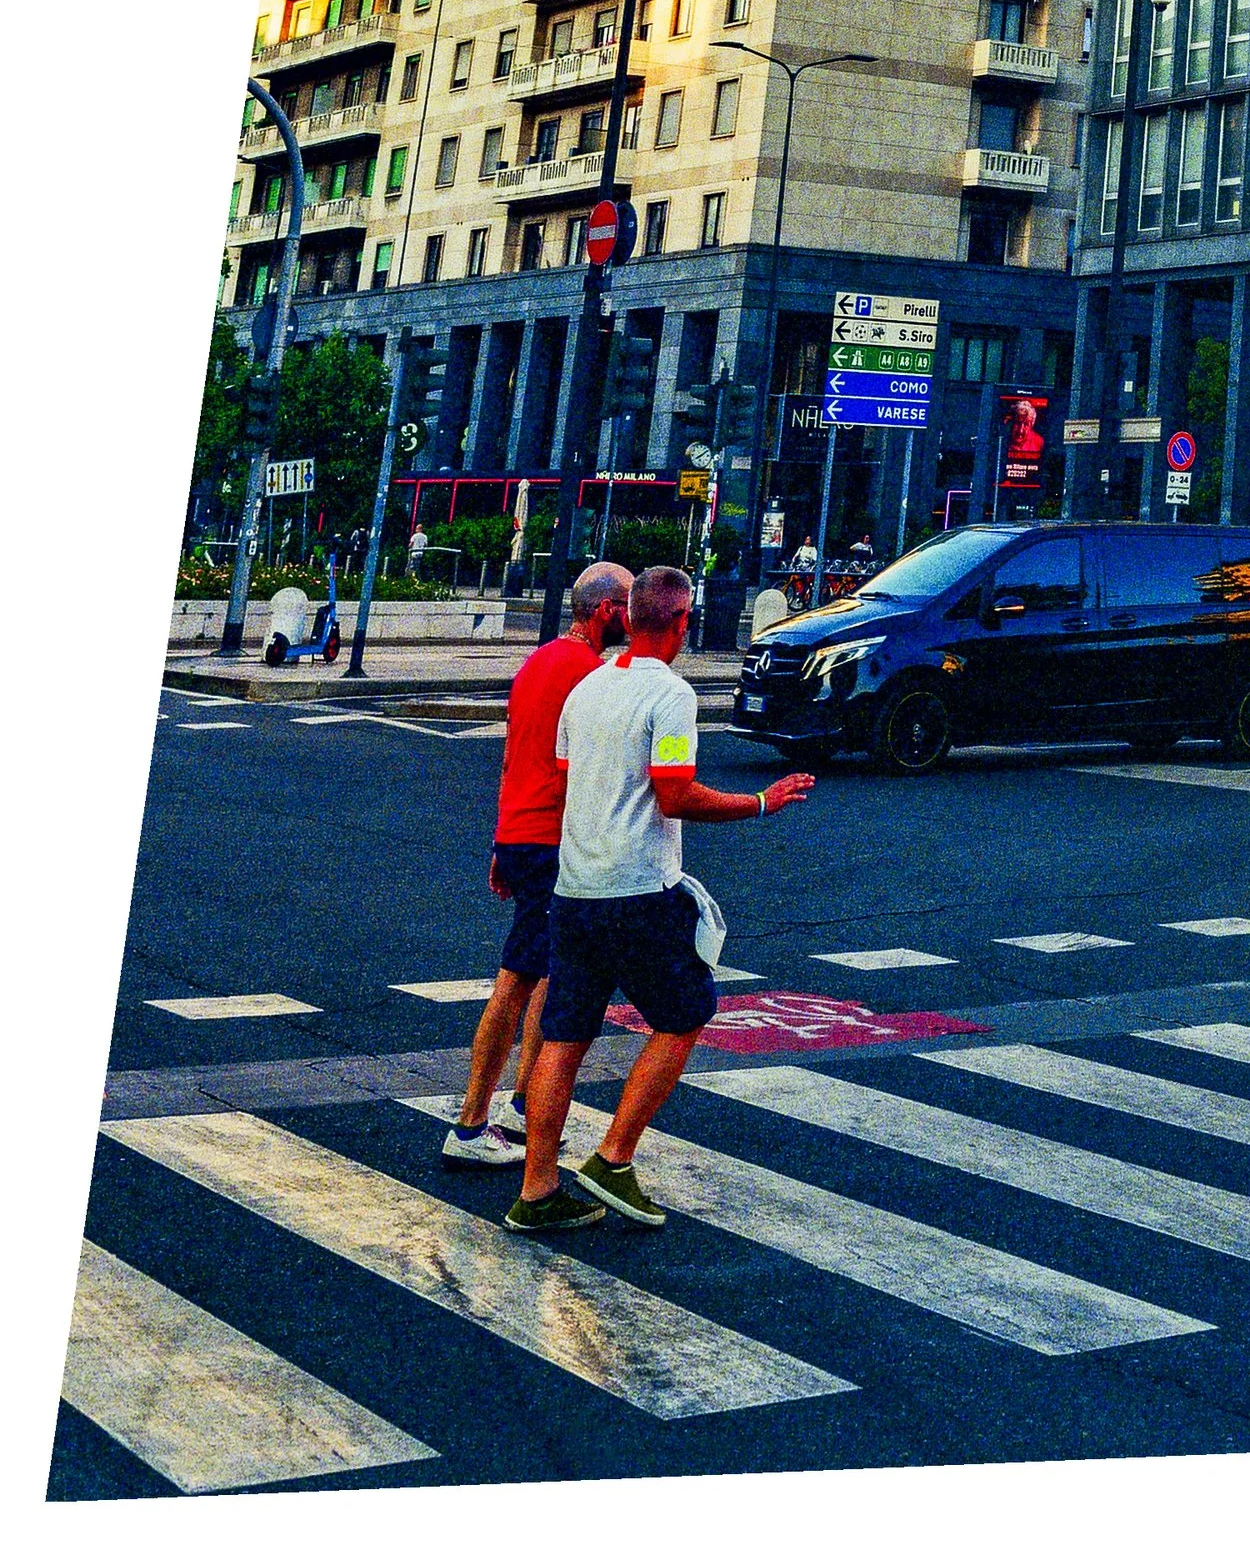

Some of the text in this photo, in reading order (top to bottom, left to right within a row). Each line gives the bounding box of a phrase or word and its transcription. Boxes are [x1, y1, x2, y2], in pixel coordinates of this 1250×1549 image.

[859, 299, 936, 317] P Pirelli
[899, 329, 933, 343] S.Siro
[881, 354, 928, 368] A4 A8 A9
[890, 381, 928, 394] COMO
[877, 406, 926, 420] VARESE
[623, 472, 656, 481] MILANO
